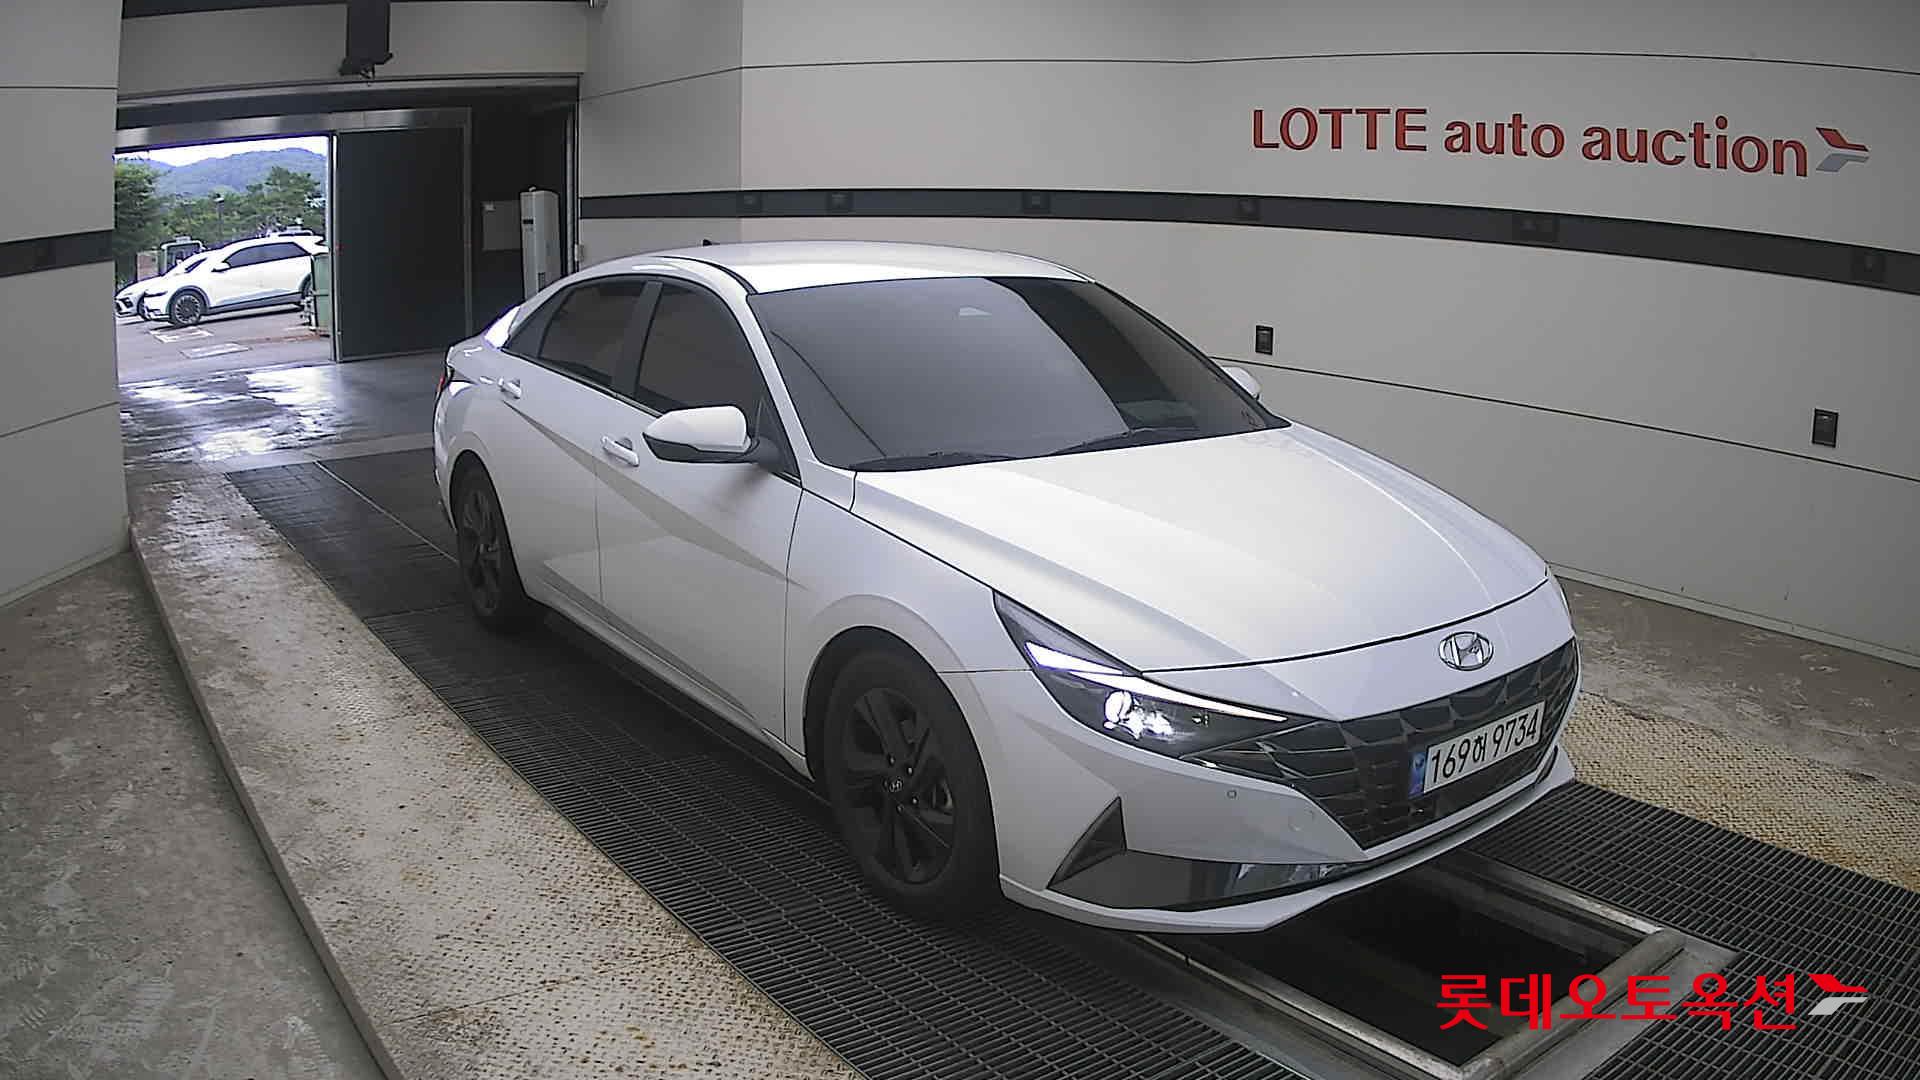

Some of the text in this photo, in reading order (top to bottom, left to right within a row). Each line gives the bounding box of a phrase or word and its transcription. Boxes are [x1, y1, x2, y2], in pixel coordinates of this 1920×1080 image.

[1253, 106, 1808, 177] LOTTE auto auction
[1492, 708, 1540, 758] 9734
